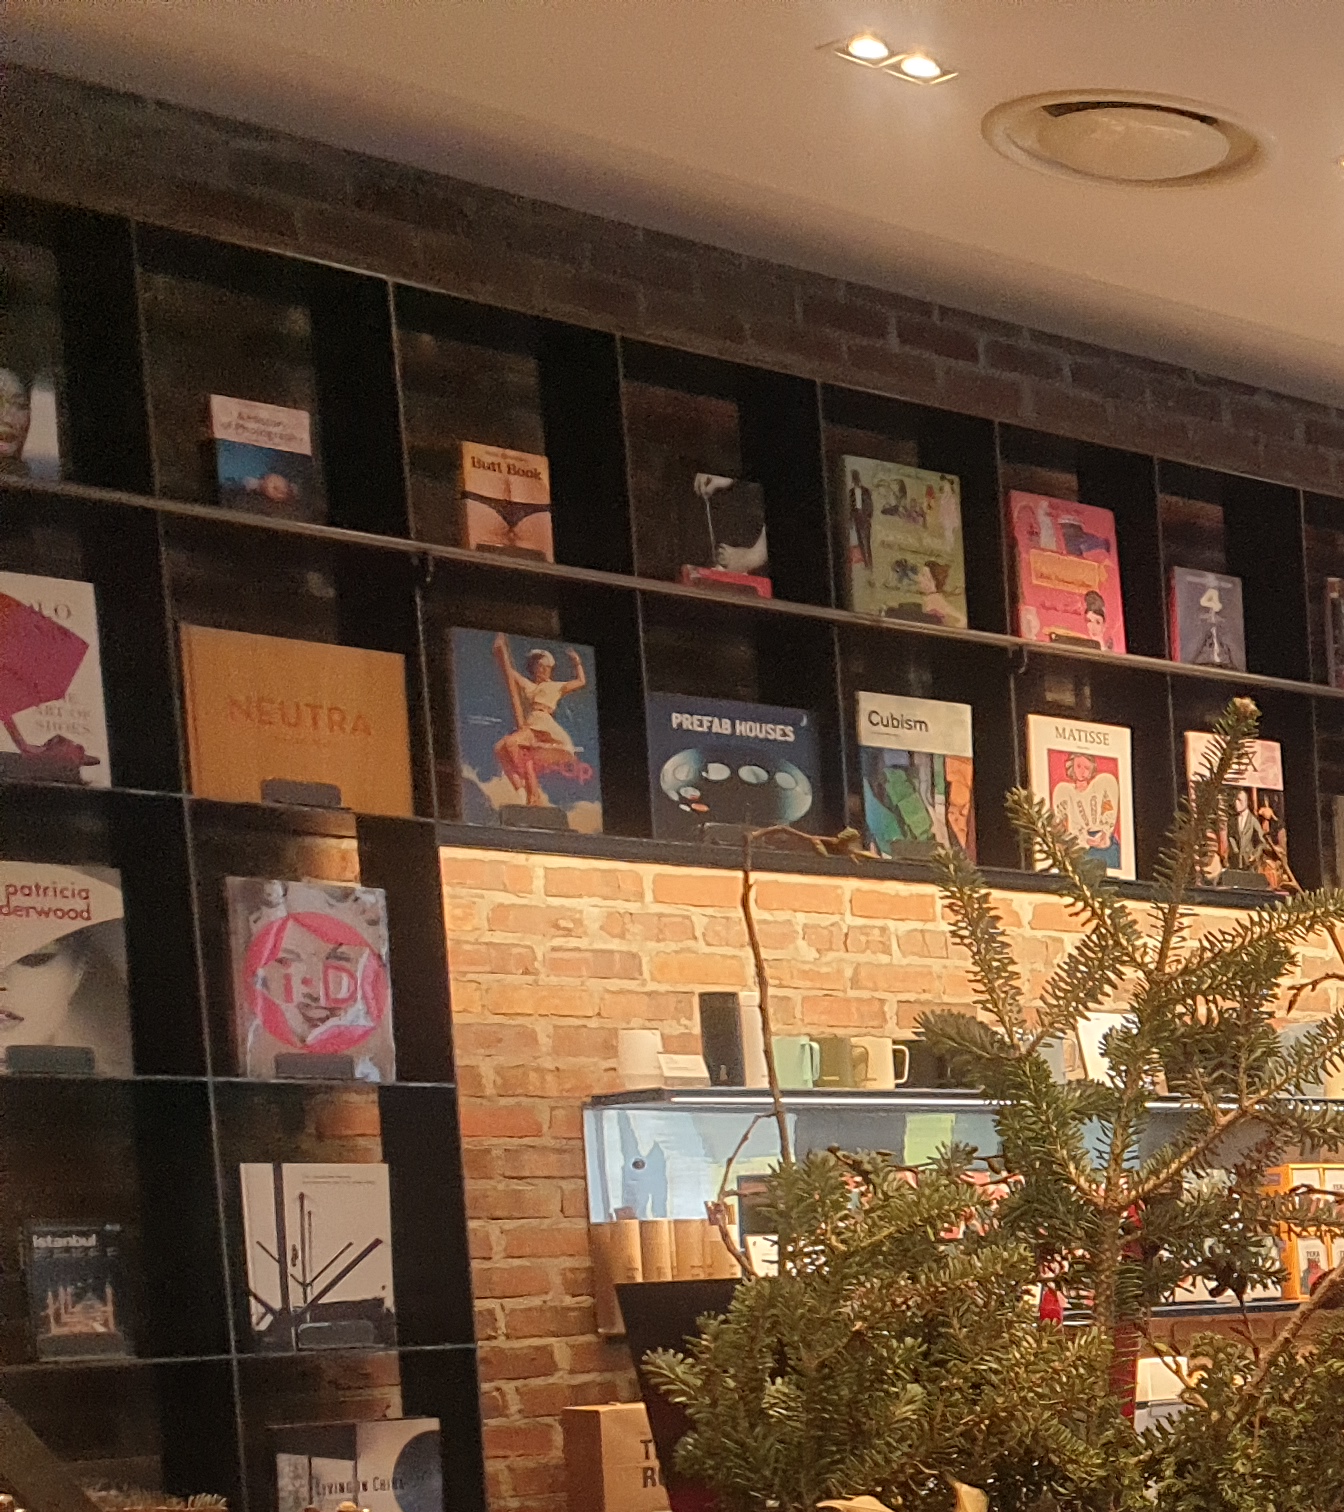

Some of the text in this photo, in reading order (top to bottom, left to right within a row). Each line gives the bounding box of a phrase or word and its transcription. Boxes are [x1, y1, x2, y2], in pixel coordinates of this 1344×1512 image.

[470, 455, 502, 473] Butt
[506, 463, 542, 482] Book
[227, 700, 372, 737] NEUTRA
[672, 712, 795, 742] PREFAB HOUSES
[868, 710, 929, 733] Cubism
[1055, 726, 1110, 746] MATISSE
[5, 882, 91, 901] patricia
